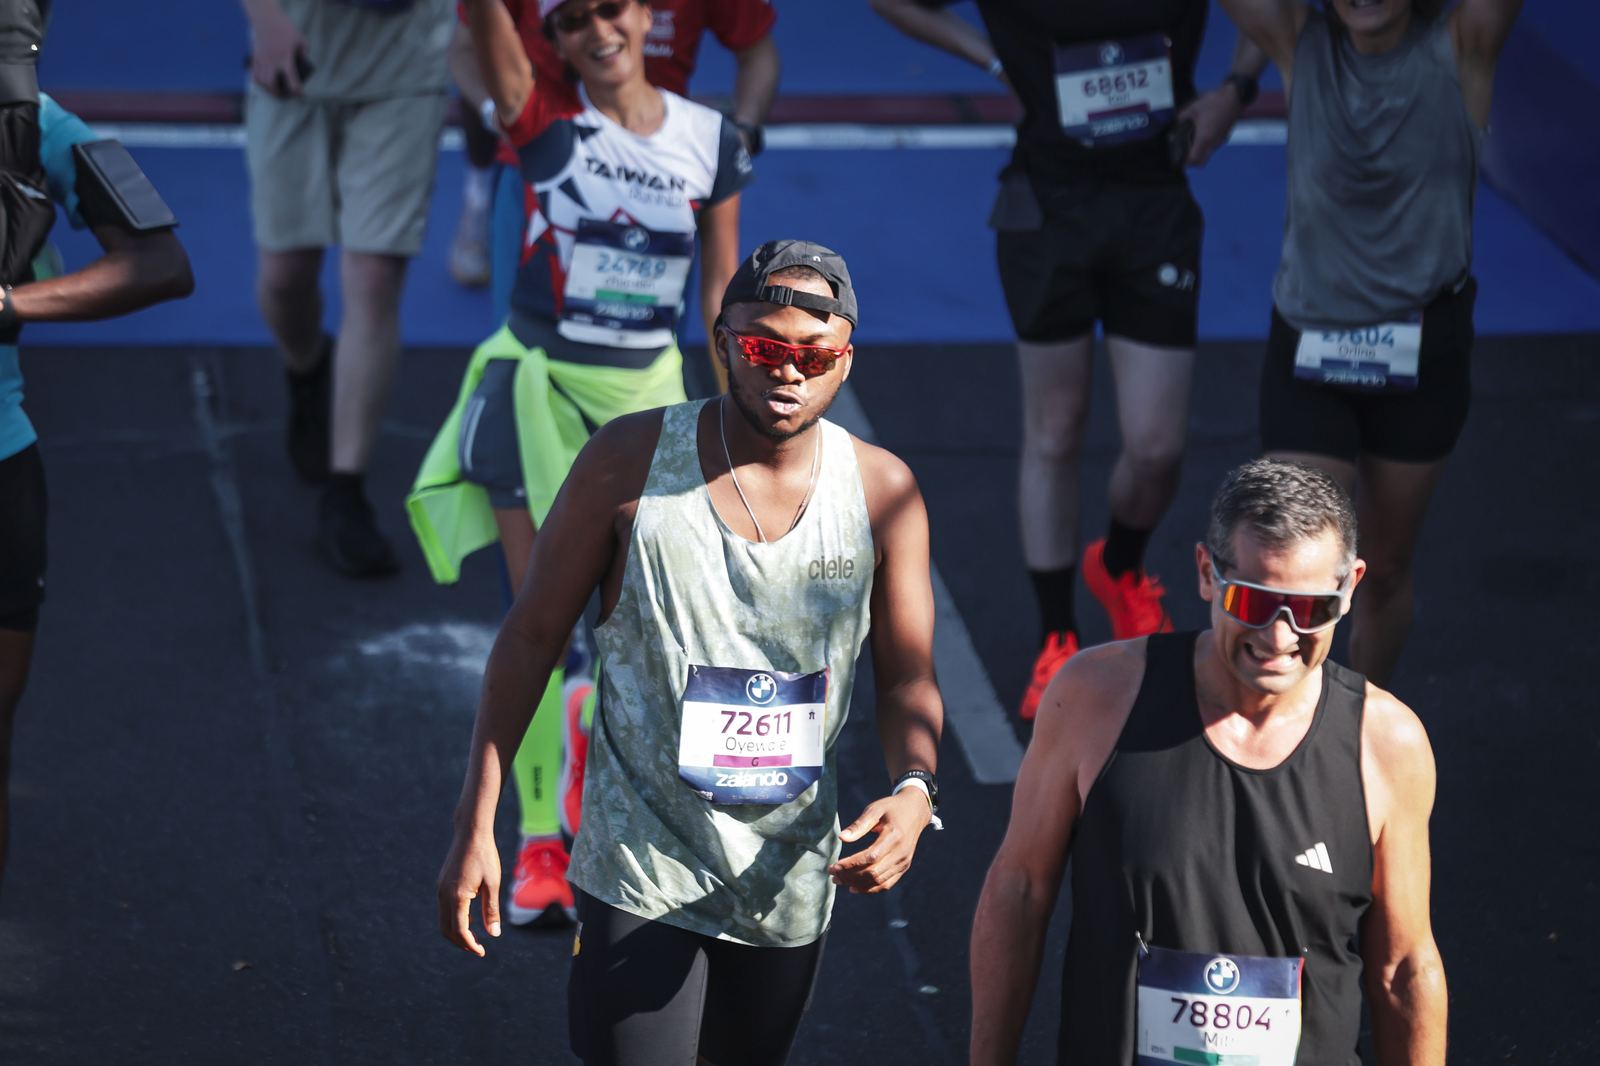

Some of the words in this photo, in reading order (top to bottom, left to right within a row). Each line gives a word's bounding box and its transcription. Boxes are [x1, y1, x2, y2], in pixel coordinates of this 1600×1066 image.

[1081, 68, 1149, 99] 68612
[585, 158, 687, 191] TAIWAN
[808, 555, 855, 580] ciele
[720, 710, 792, 737] 72611
[751, 757, 759, 767] G
[715, 770, 788, 788] zalando
[1170, 997, 1271, 1031] 78804
